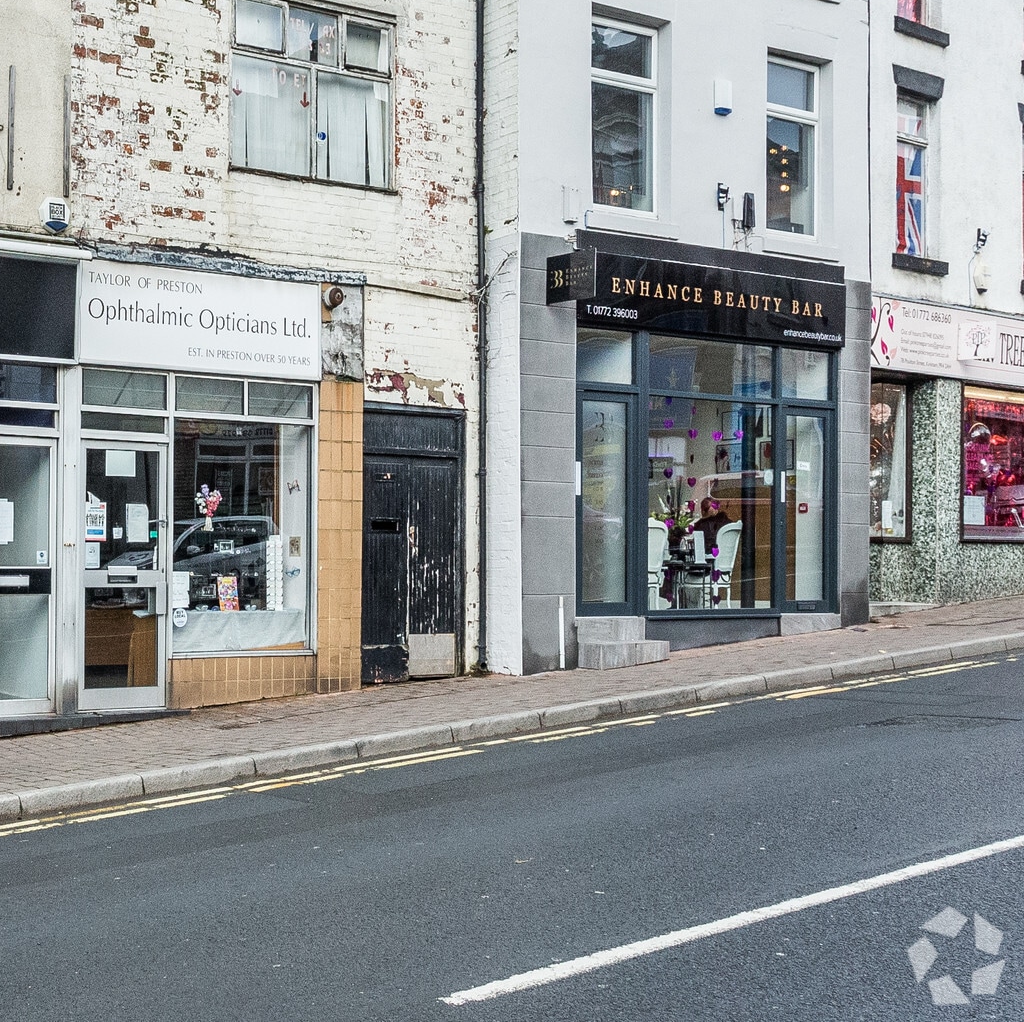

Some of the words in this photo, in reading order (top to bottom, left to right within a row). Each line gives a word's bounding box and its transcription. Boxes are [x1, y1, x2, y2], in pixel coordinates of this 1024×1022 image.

[88, 271, 131, 287] TAYLOR
[137, 276, 152, 289] OF
[156, 279, 203, 294] PRESTON
[611, 277, 703, 304] ENHANCE
[713, 290, 782, 313] BEAUTY
[792, 300, 824, 318] BAR
[88, 297, 193, 328] Ophthalmic
[199, 308, 278, 336] Opticians
[283, 317, 311, 339] Ltd.
[586, 304, 592, 314] T.
[593, 305, 611, 317] 01772
[612, 308, 638, 320] 396003
[912, 308, 930, 321] 01772
[188, 347, 203, 358] EST.
[206, 349, 215, 358] IN
[216, 350, 253, 361] PRESTON
[254, 352, 275, 363] OVER
[277, 354, 286, 364] 50
[288, 355, 311, 366] YEARS
